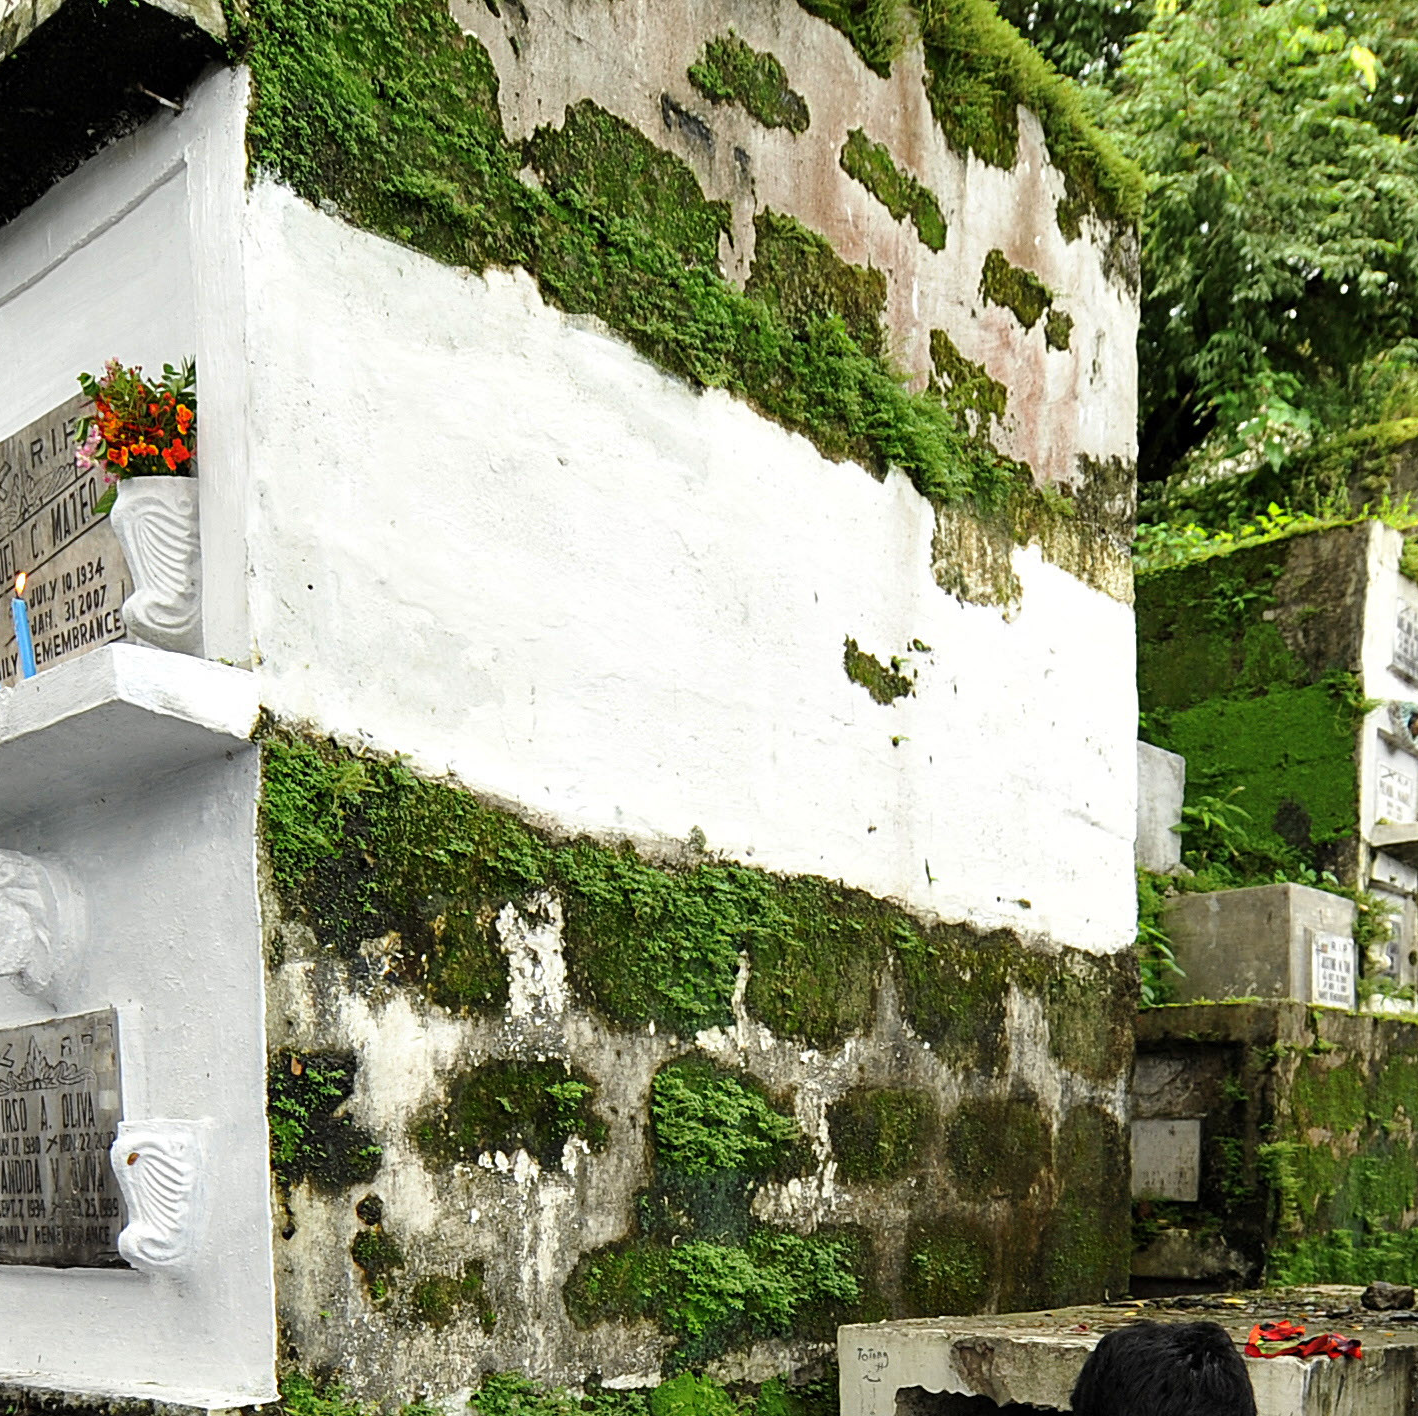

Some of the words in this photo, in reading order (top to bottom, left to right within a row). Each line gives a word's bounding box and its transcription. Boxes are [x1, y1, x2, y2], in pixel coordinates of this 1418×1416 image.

[31, 523, 45, 560] C.
[52, 477, 98, 547] MATEO
[35, 608, 121, 665] EMEMBRANCE
[61, 1091, 96, 1128] OLIVA
